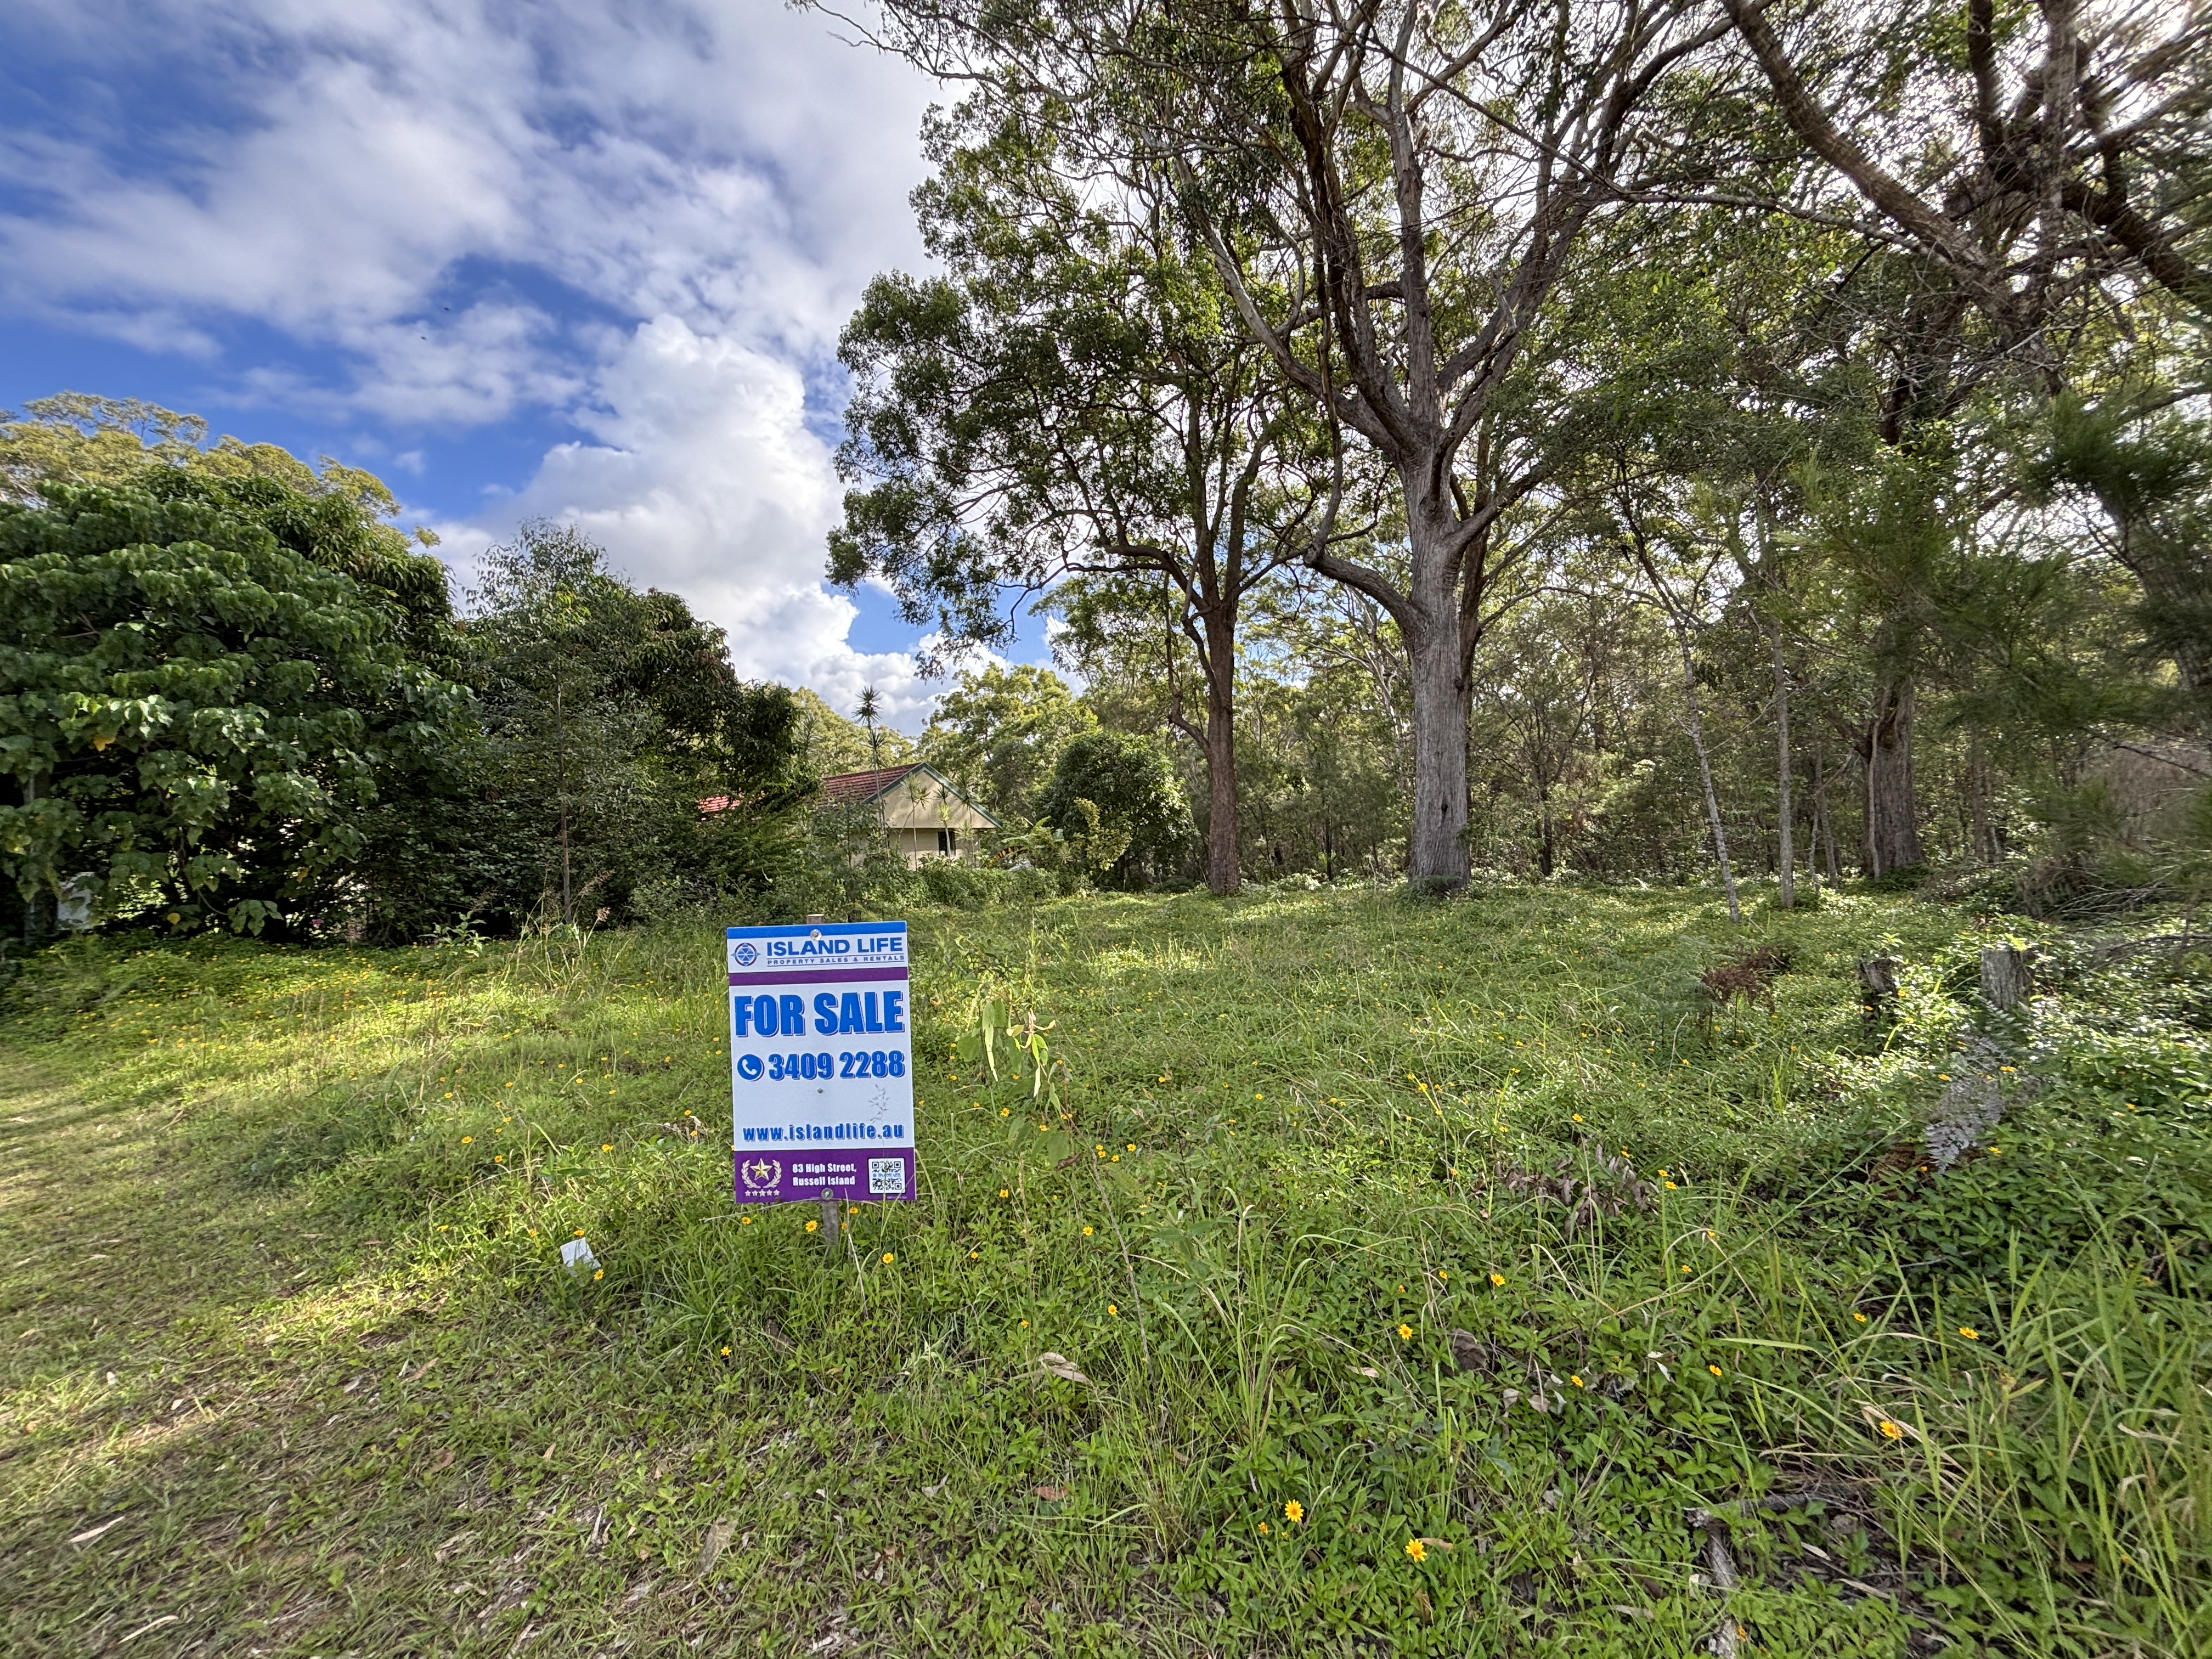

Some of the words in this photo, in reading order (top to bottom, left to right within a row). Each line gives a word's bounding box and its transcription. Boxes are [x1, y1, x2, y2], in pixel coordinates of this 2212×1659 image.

[766, 939, 850, 956] ISLAND
[857, 937, 903, 953] LIFE
[734, 994, 806, 1038] FOR
[814, 990, 905, 1036] SALE
[768, 1052, 834, 1081] 3409
[839, 1050, 905, 1079] 2288
[743, 1123, 904, 1141] www.islandlife.au
[792, 1164, 804, 1173] 83
[805, 1163, 826, 1173] High
[827, 1163, 856, 1173] Street,
[793, 1176, 826, 1186] Russell
[827, 1176, 855, 1185] Island
